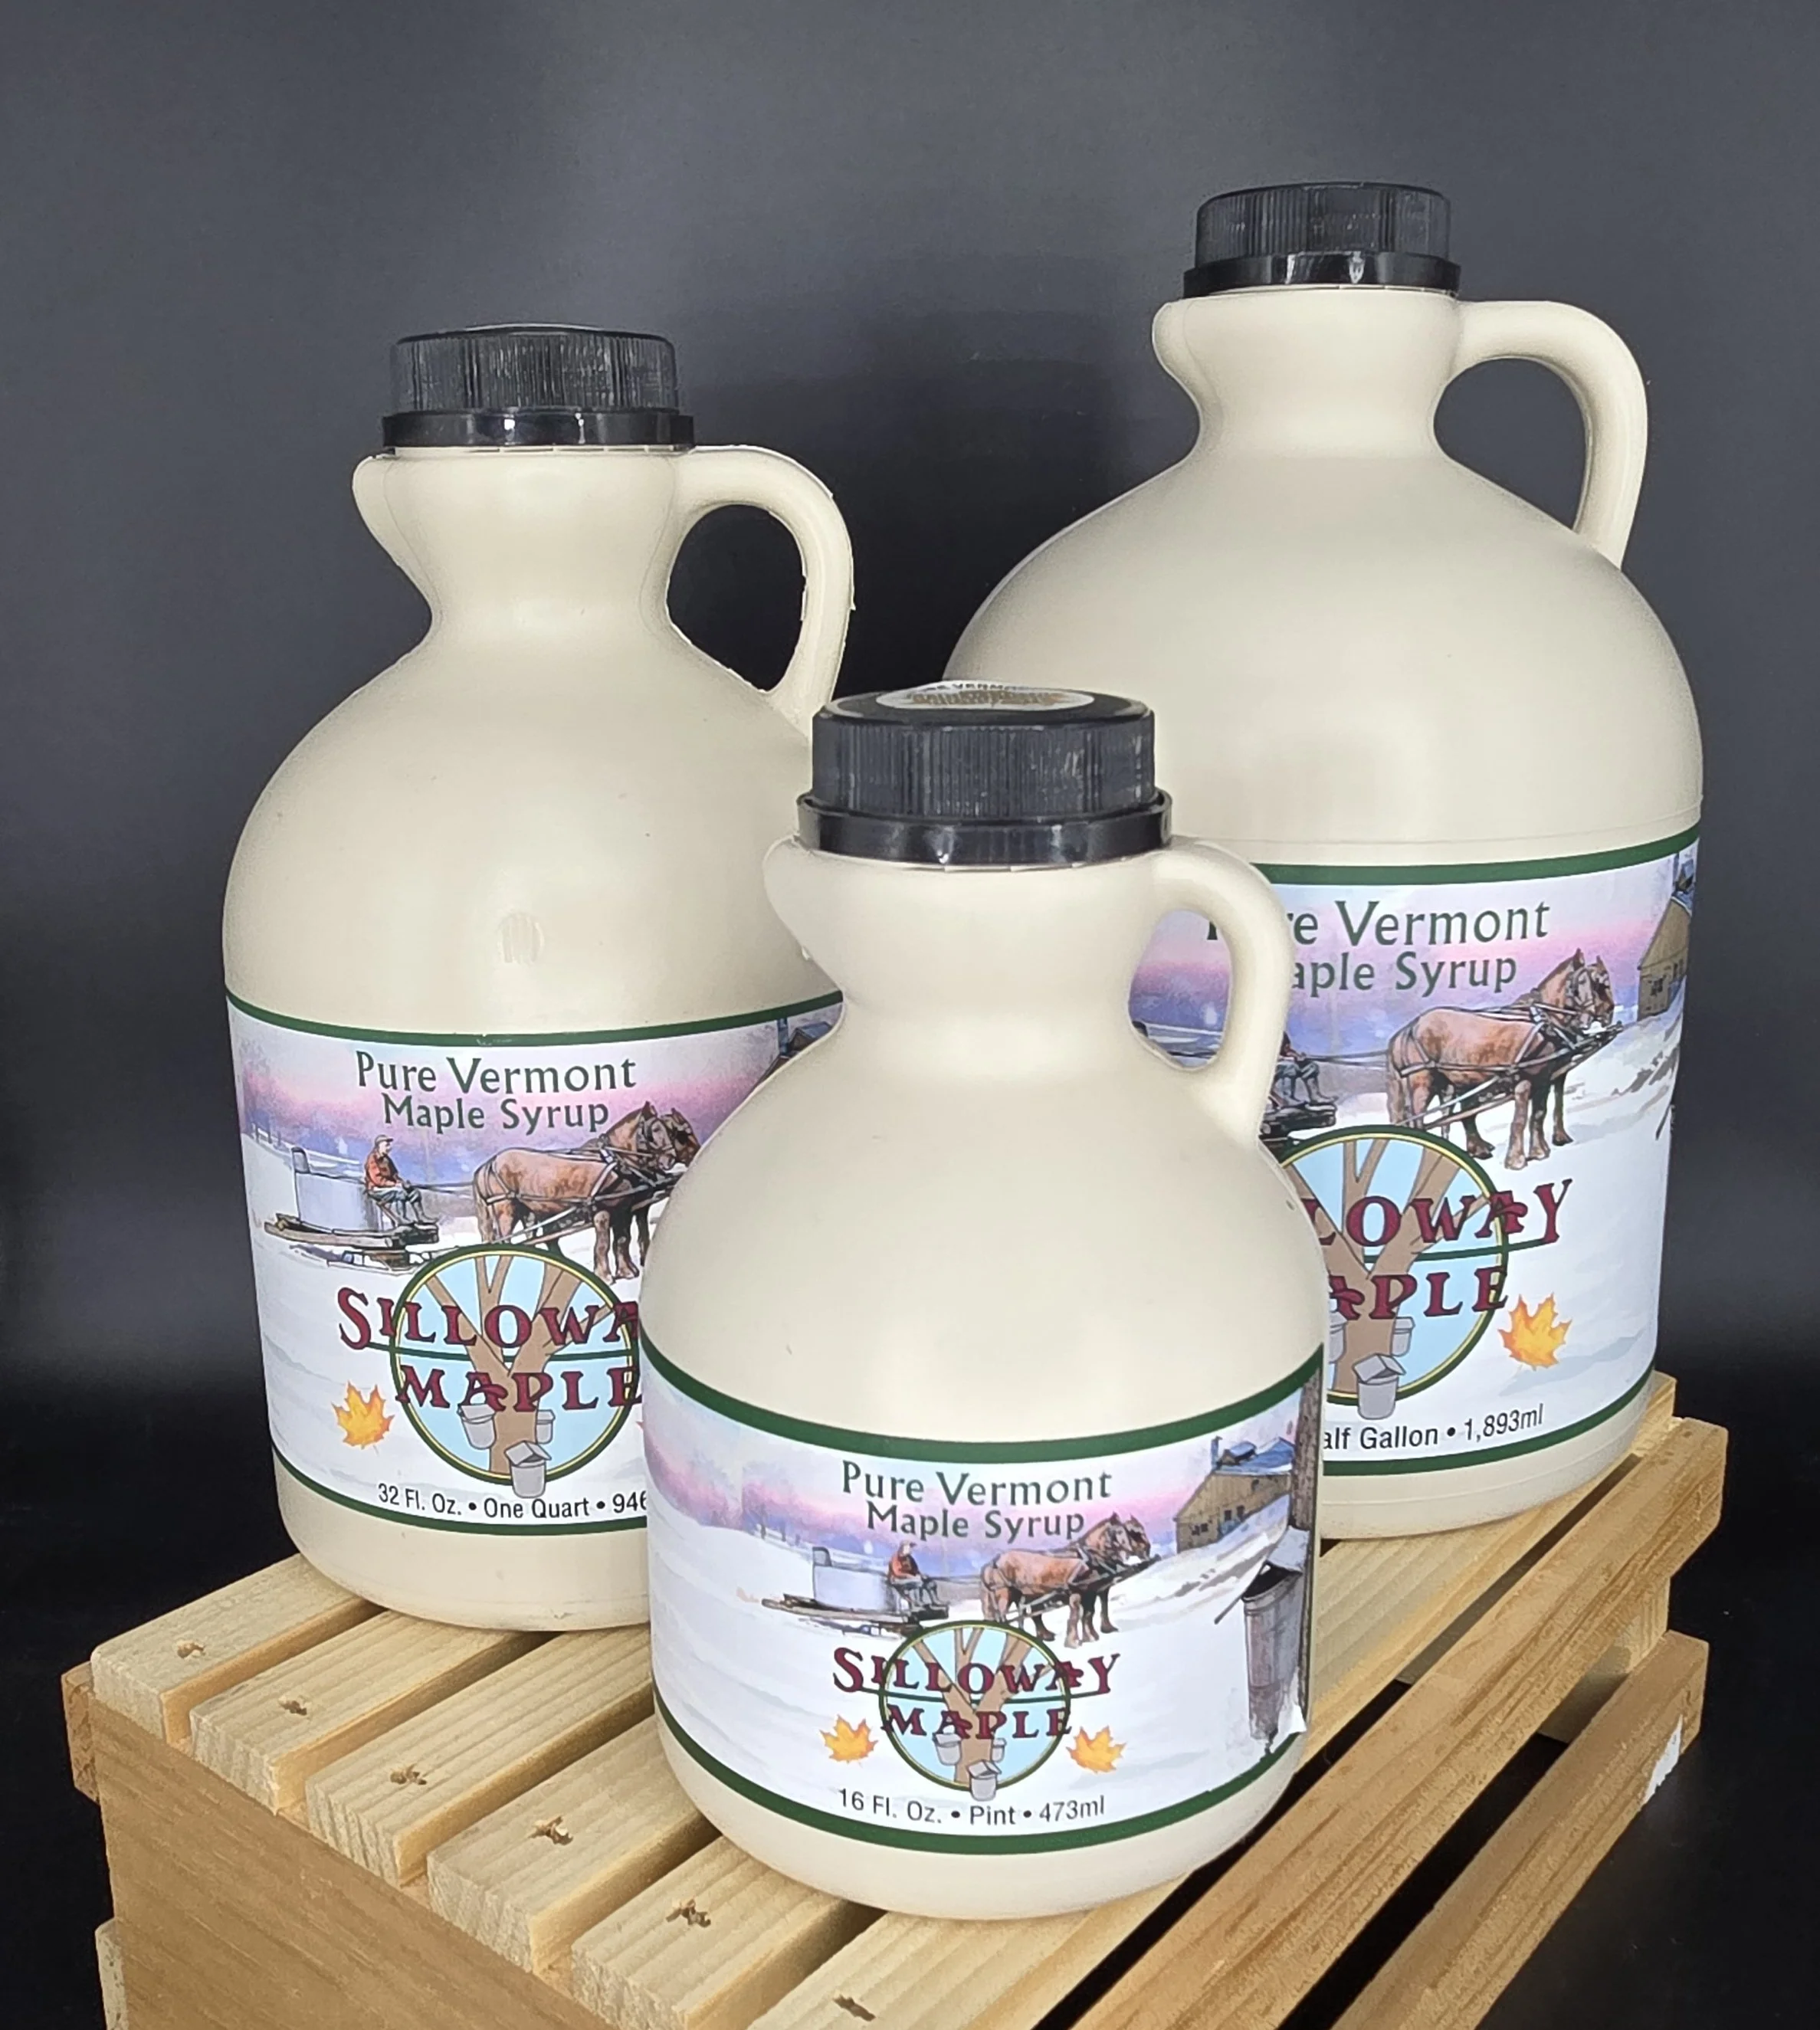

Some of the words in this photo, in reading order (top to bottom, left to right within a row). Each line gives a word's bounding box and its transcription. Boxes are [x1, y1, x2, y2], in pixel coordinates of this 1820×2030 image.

[1334, 900, 1549, 946] Vermont
[1292, 951, 1375, 998] aple
[1395, 951, 1517, 997] Syrup
[356, 1051, 437, 1092] Pure
[446, 1057, 636, 1094] Vermont
[382, 1093, 485, 1134] Maple
[501, 1099, 609, 1134] Syrup
[1330, 1266, 1508, 1320] APLE
[338, 1287, 639, 1350] SILLOWA
[396, 1365, 642, 1412] MAPLE
[1323, 1427, 1351, 1449] alf
[1360, 1425, 1438, 1450] Gallon
[1464, 1403, 1543, 1442] 1,893ml
[379, 1483, 399, 1507] 32
[406, 1488, 426, 1512] Fl.
[433, 1494, 461, 1516] Oz.
[484, 1498, 524, 1518] One
[532, 1497, 589, 1518] Quart
[612, 1490, 647, 1513] 946
[842, 1461, 924, 1501] Pure
[936, 1471, 1113, 1506] Vermont
[866, 1500, 969, 1540] Maple
[985, 1510, 1084, 1543] Syrup
[834, 1647, 1120, 1694] SILLOWAY
[880, 1704, 1071, 1740] MAPLE
[839, 1789, 864, 1811] 16
[874, 1796, 897, 1818] Fl.
[907, 1800, 942, 1823] Oz.
[971, 1805, 1016, 1825] Pint
[1040, 1795, 1104, 1822] 473ml
